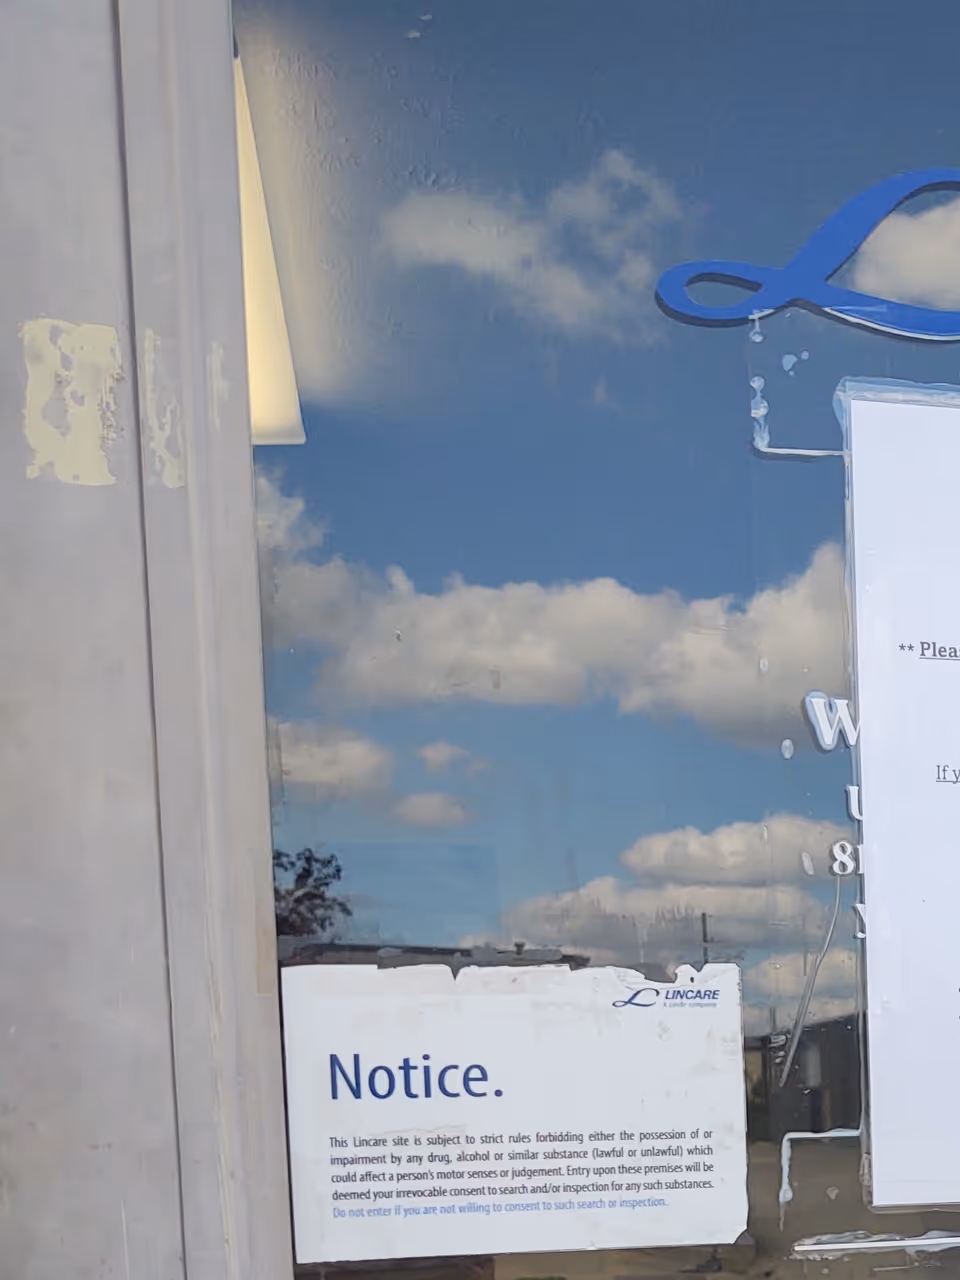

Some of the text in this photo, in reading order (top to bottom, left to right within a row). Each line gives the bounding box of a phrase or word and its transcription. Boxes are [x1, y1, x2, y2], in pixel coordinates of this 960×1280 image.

[936, 764, 950, 781] If
[665, 989, 720, 1000] LINCARE
[329, 1053, 503, 1100] Notice.
[329, 1127, 713, 1148] This Lincare site is subject to strict rules forbidding either the possession of or
[330, 1145, 714, 1168] impairment by any drug, alcohol or similar substance (lawful or unlawful) which
[331, 1179, 715, 1203] deemed your irrevocable consent to search and/or inspection for any such substances.
